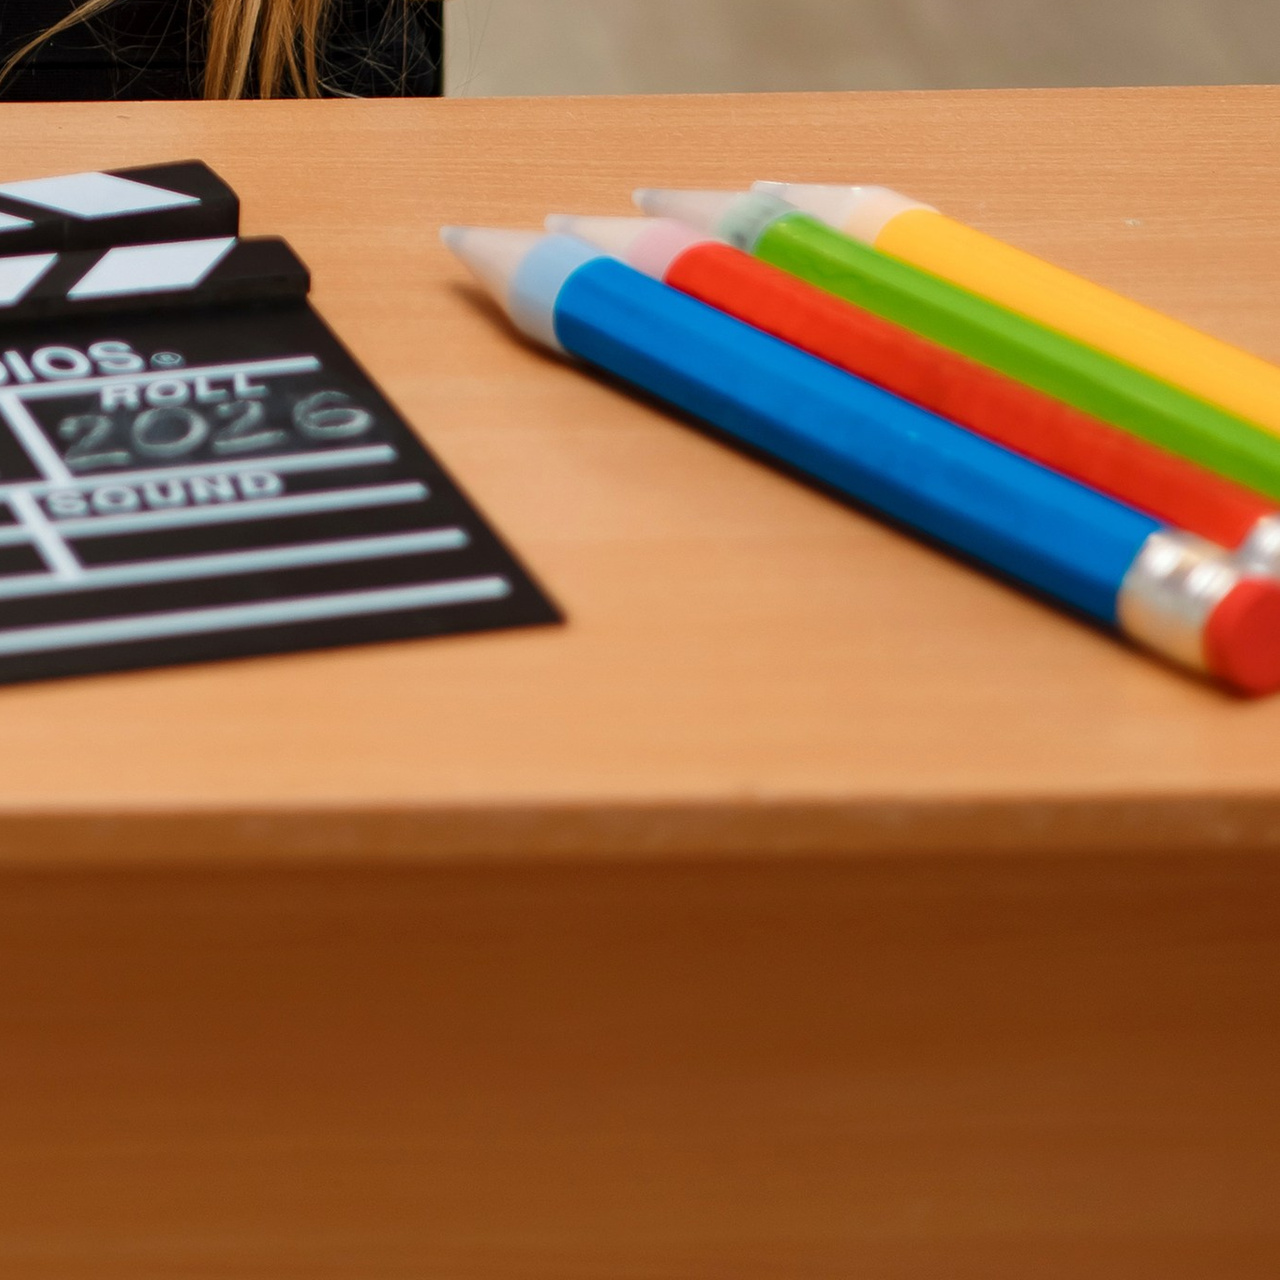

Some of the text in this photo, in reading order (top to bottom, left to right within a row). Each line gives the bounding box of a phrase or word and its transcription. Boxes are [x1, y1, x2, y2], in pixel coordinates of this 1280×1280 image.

[100, 371, 268, 411] ROLL
[57, 390, 373, 470] 2026
[44, 470, 285, 518] SOUND
